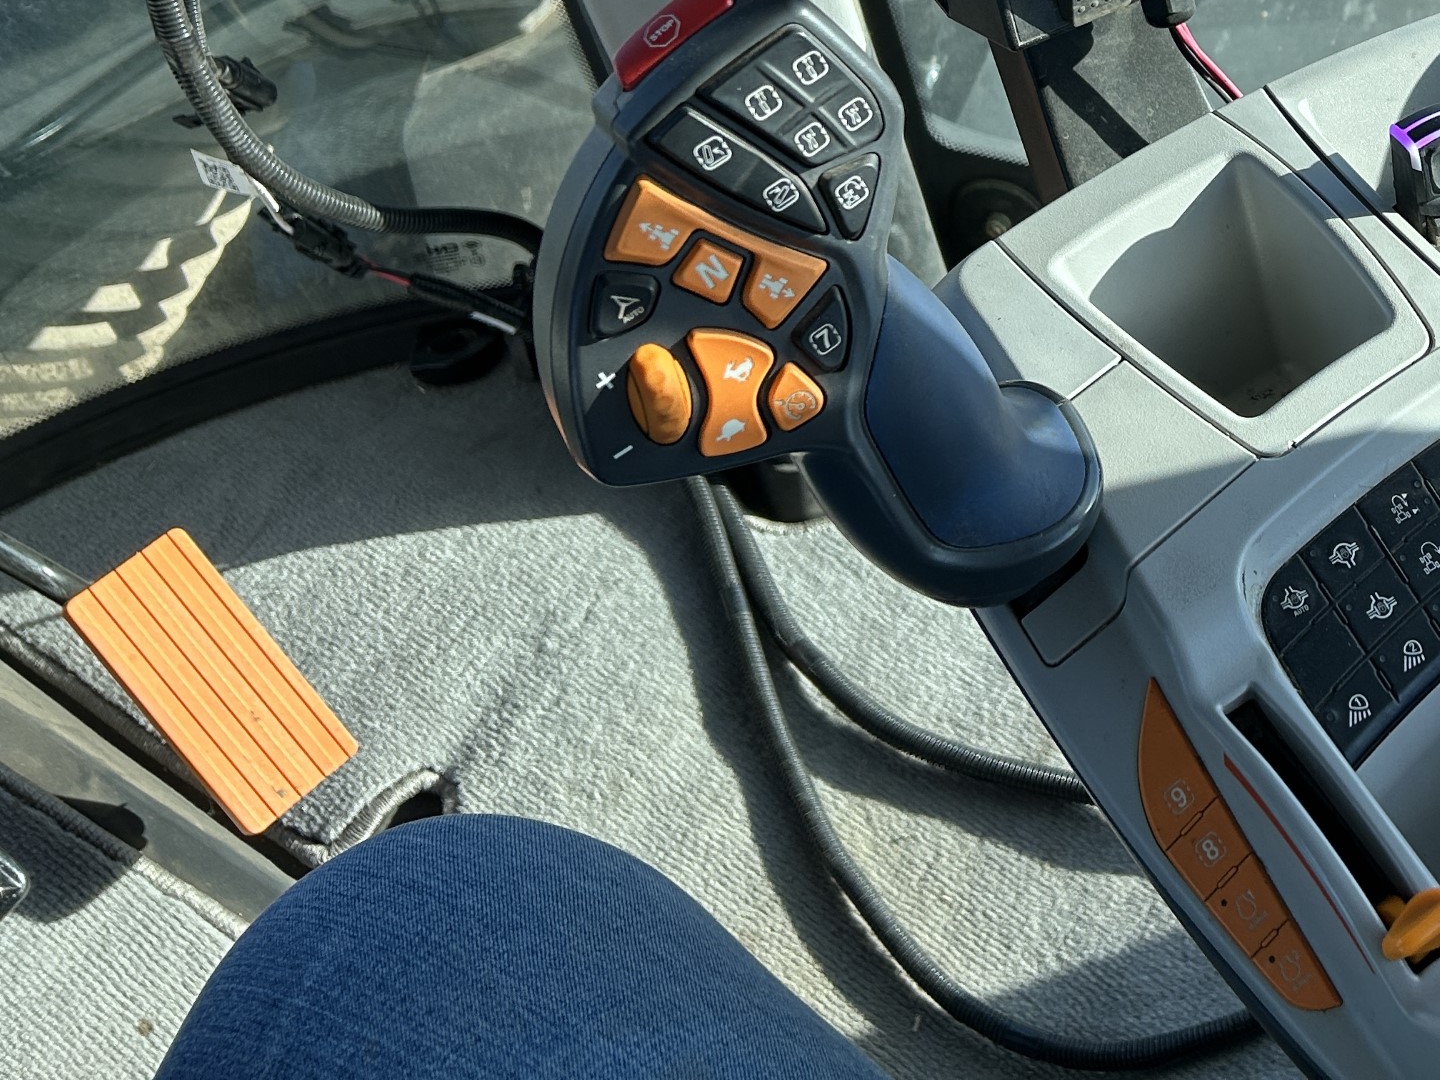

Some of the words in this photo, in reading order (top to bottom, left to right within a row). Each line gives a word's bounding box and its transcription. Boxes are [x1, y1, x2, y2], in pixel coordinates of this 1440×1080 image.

[649, 18, 675, 43] STOP
[695, 254, 729, 289] N
[622, 306, 645, 324] AUTO
[815, 330, 831, 350] 7
[1293, 603, 1310, 618] AUTO
[1408, 642, 1419, 653] 2
[1171, 787, 1188, 808] 9
[1202, 839, 1219, 860] 8
